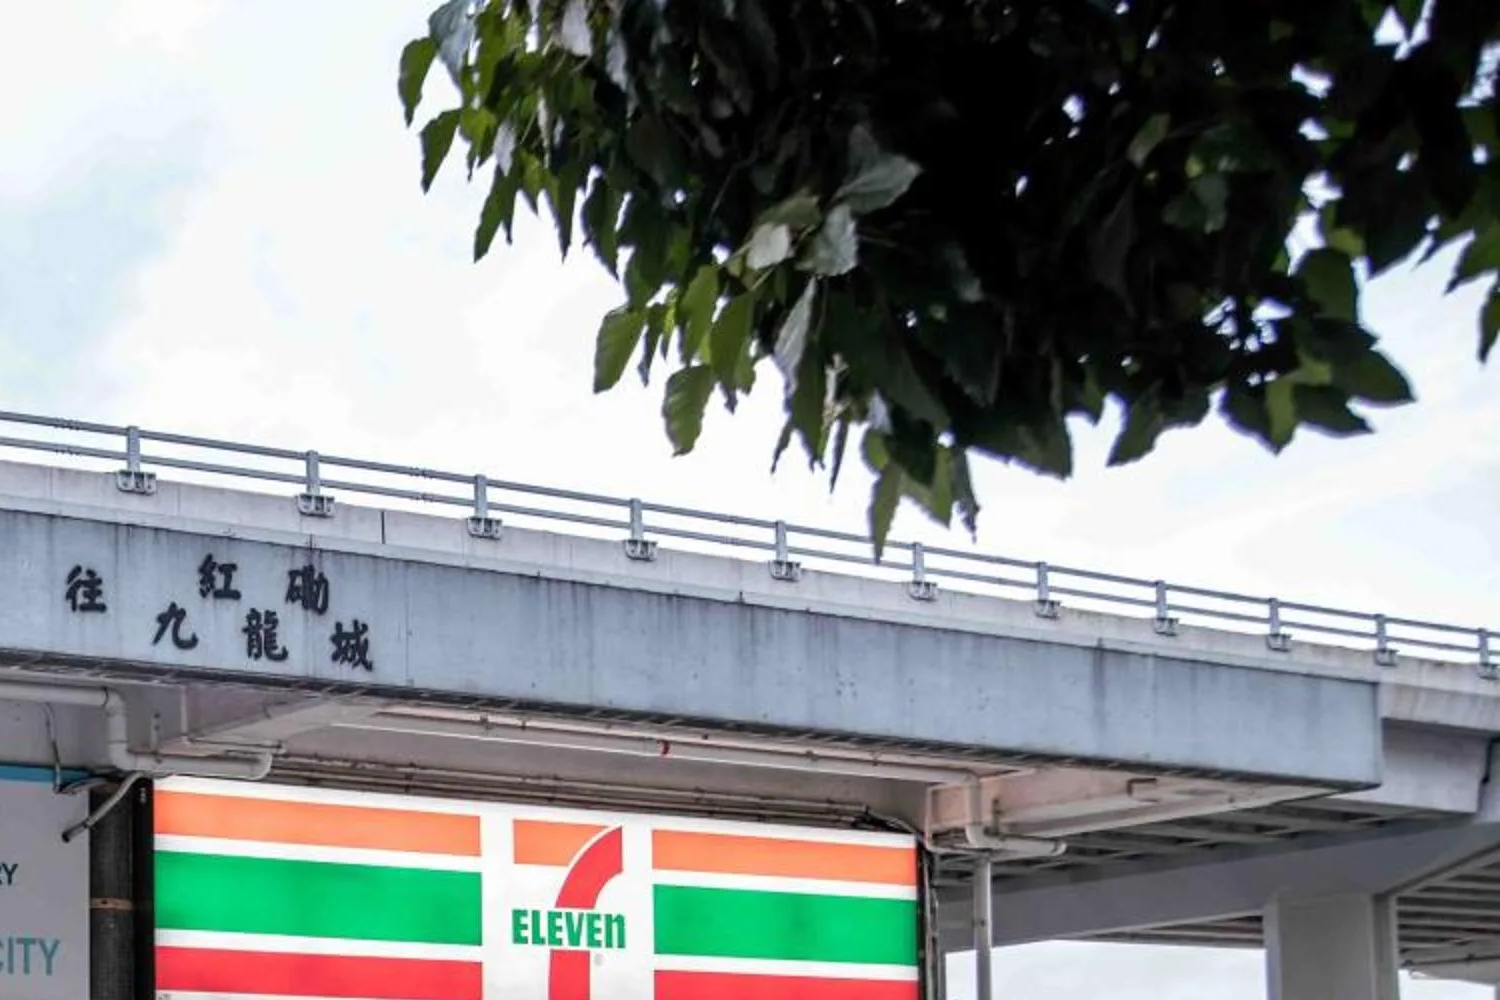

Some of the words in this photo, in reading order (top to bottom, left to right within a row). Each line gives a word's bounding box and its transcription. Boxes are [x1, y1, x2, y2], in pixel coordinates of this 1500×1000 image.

[65, 564, 107, 613] 往
[151, 602, 374, 672] 九龍城
